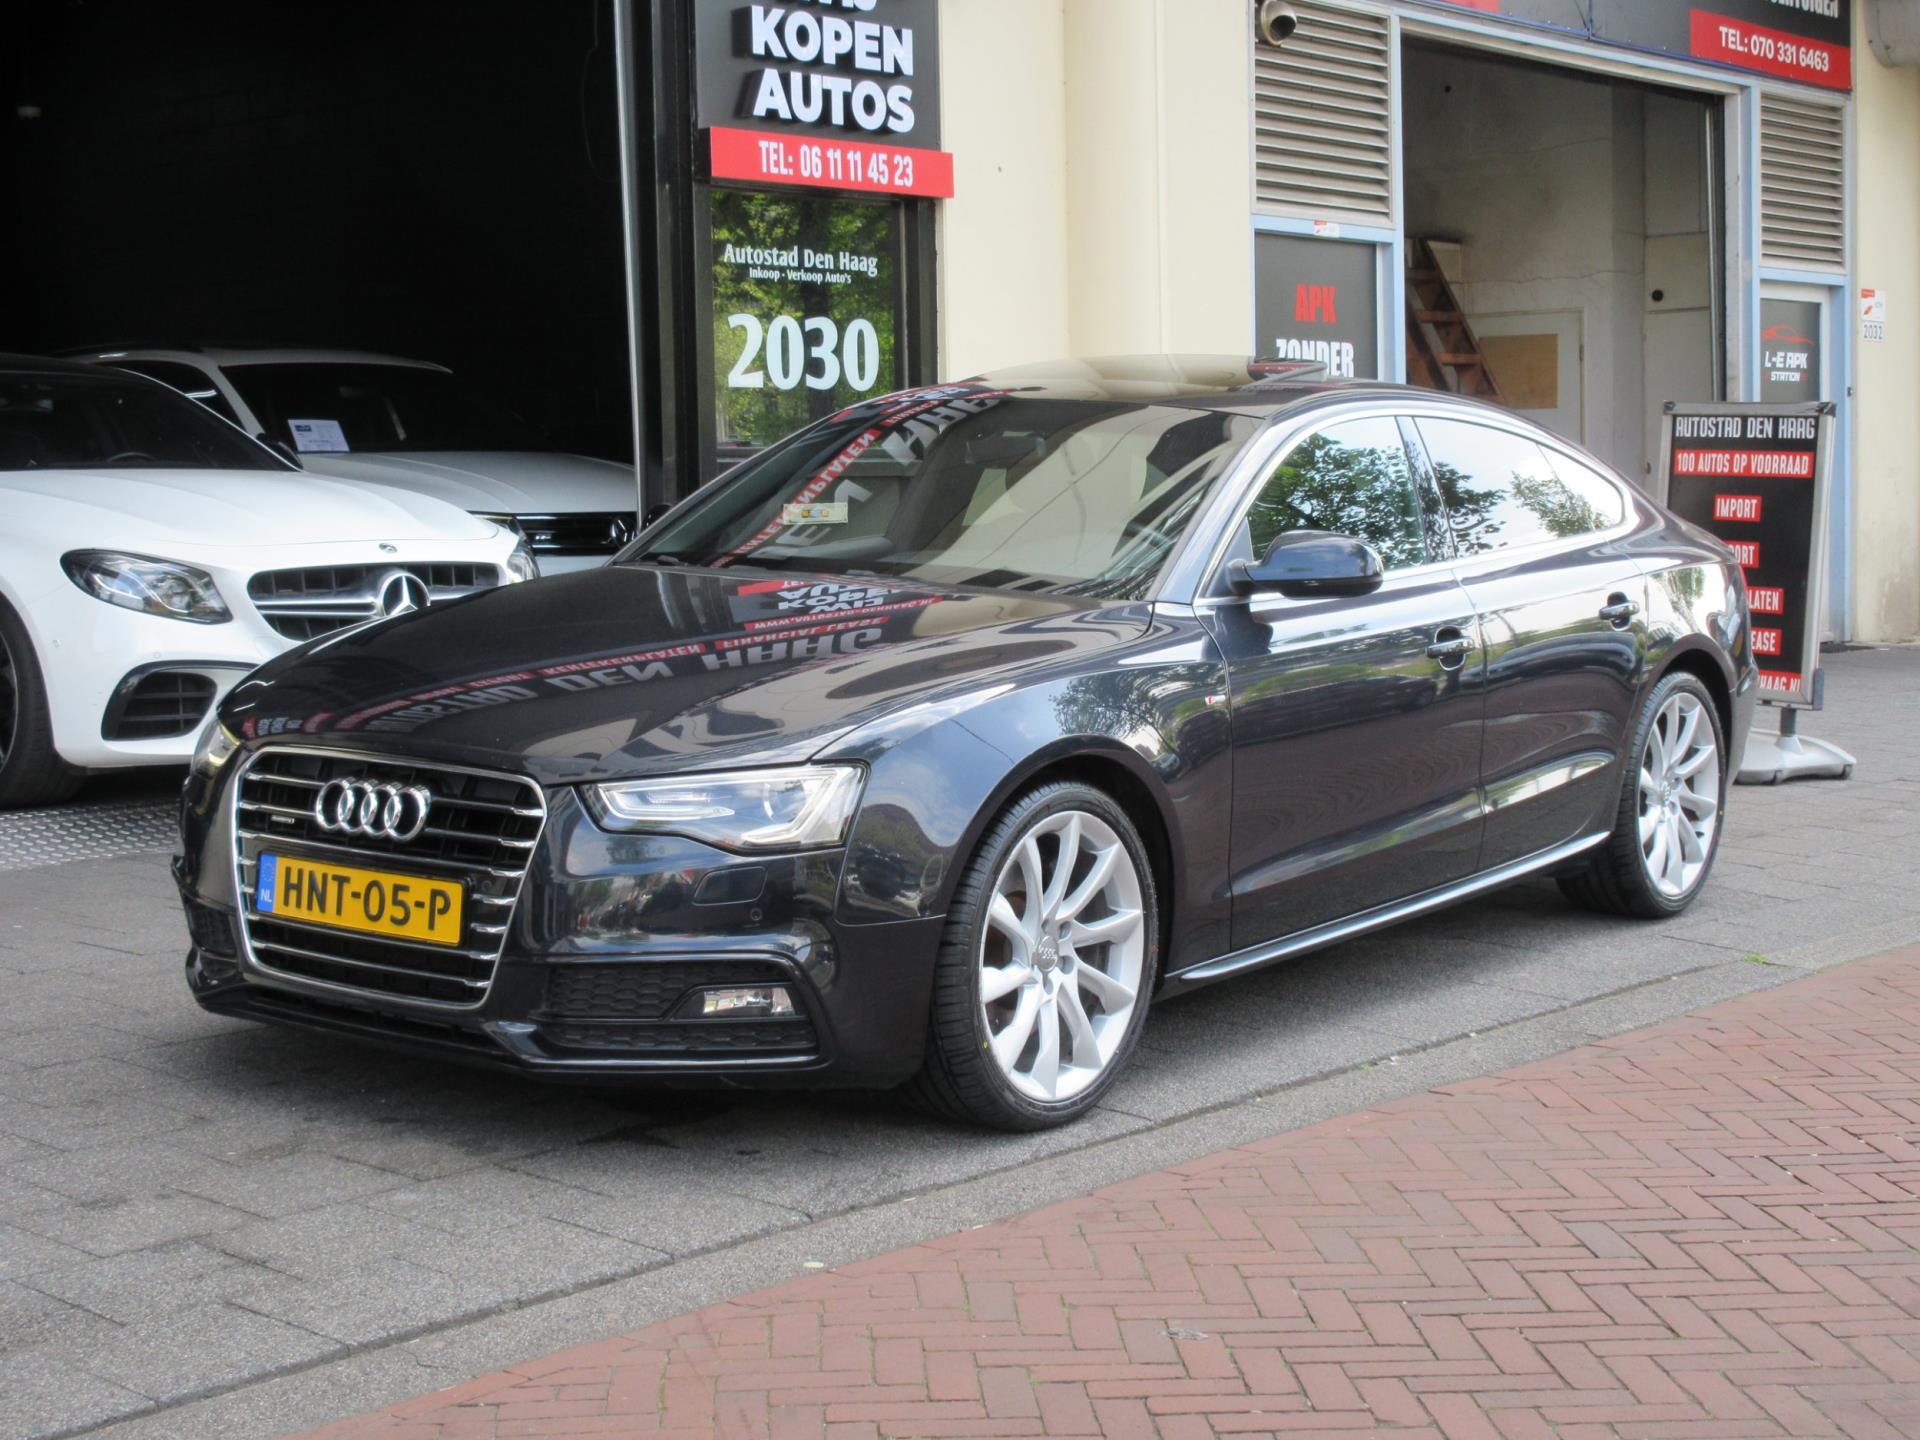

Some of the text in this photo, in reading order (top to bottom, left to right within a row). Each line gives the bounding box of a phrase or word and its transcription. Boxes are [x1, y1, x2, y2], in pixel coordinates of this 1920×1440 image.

[751, 5, 914, 76] KOPEN
[1719, 25, 1829, 72] TEL: 070 331 6463
[753, 68, 915, 133] AUTOS
[759, 140, 913, 187] TEL: 06 11 11 45 23
[723, 243, 878, 277] Autostad Den Haag
[749, 266, 852, 285] Inkoop Verkoop Auto's
[1295, 283, 1337, 324] APK
[727, 313, 880, 391] 2030
[1785, 351, 1808, 369] APK
[1675, 416, 1816, 440] AUTOSTAD DEN HAAG
[1678, 452, 1809, 475] 100 AUTOS OP VOORRAAD
[1716, 497, 1758, 518] IMPORT
[1748, 589, 1779, 611] LATEN
[1751, 631, 1777, 652] EASE
[260, 865, 451, 931] NL HNT-05-P
